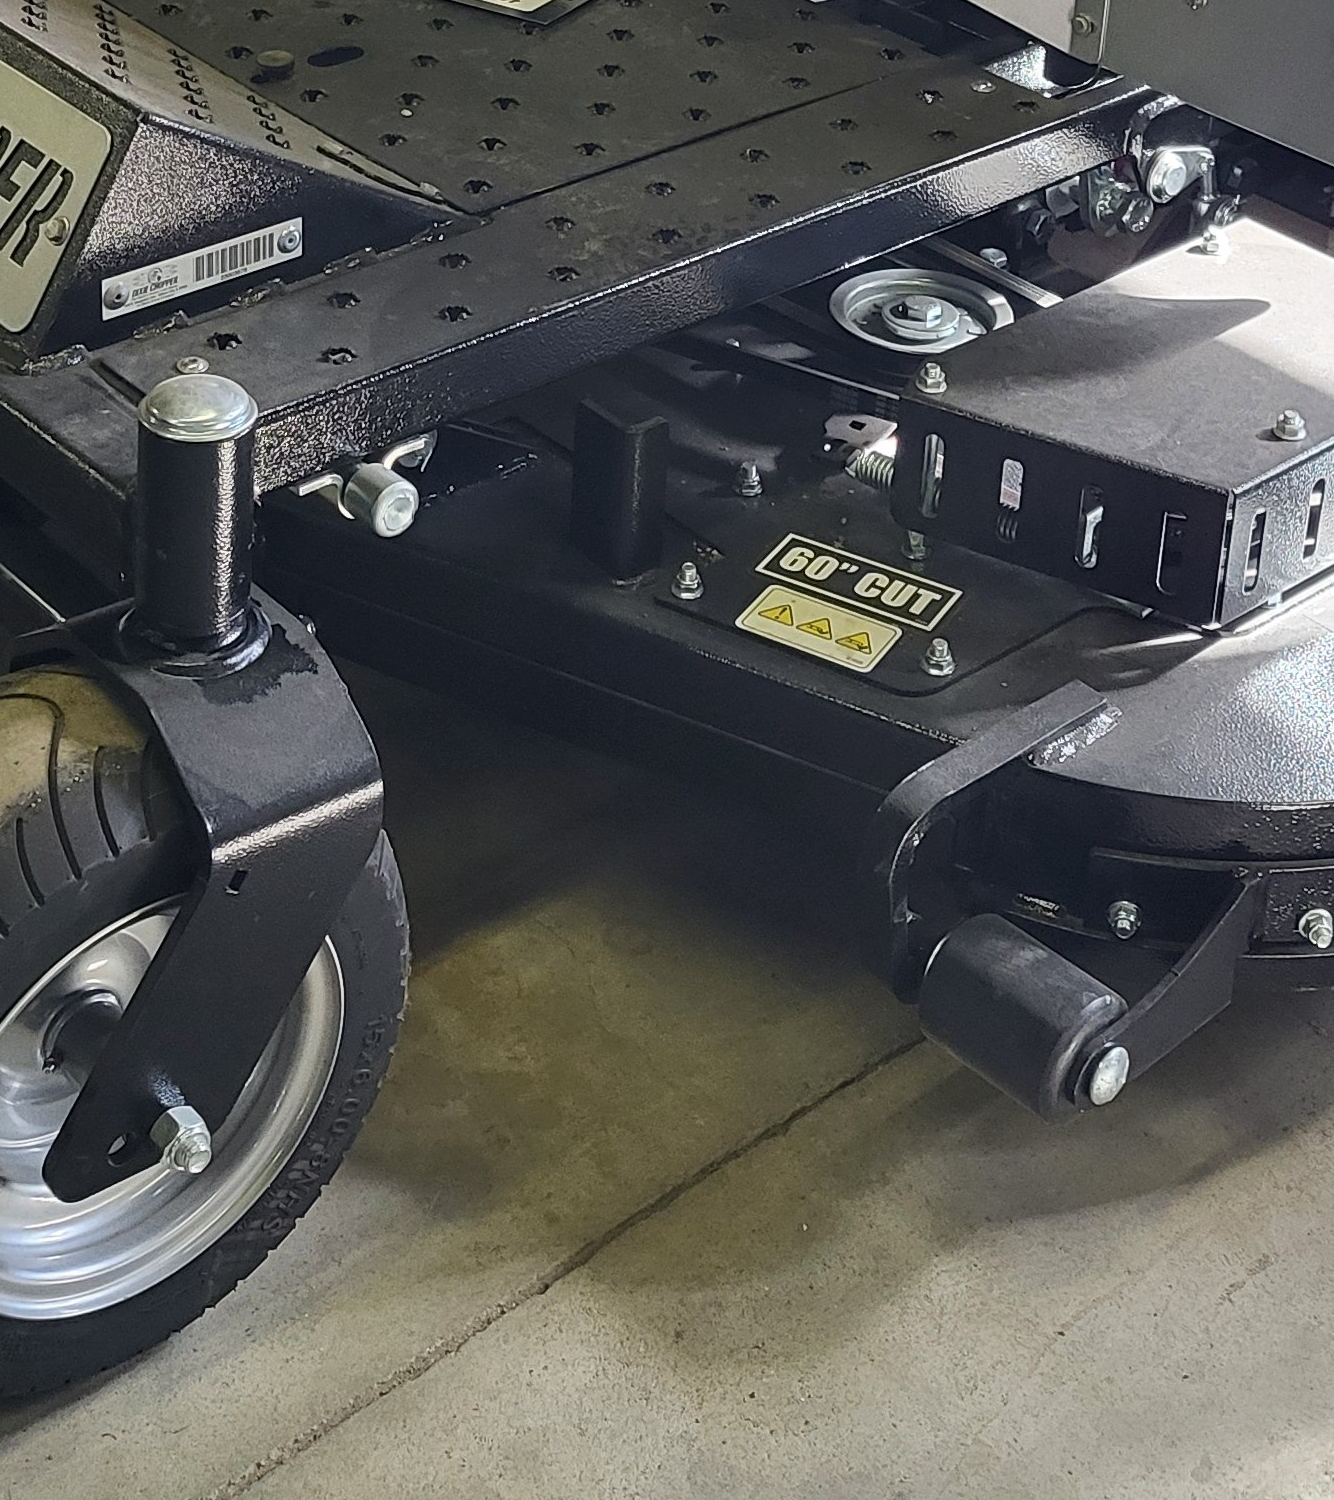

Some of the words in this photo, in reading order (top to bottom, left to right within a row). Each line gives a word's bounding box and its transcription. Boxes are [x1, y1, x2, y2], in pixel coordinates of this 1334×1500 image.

[132, 285, 149, 298] DIXIE
[150, 276, 178, 291] CHOPPER
[853, 572, 943, 615] CUT
